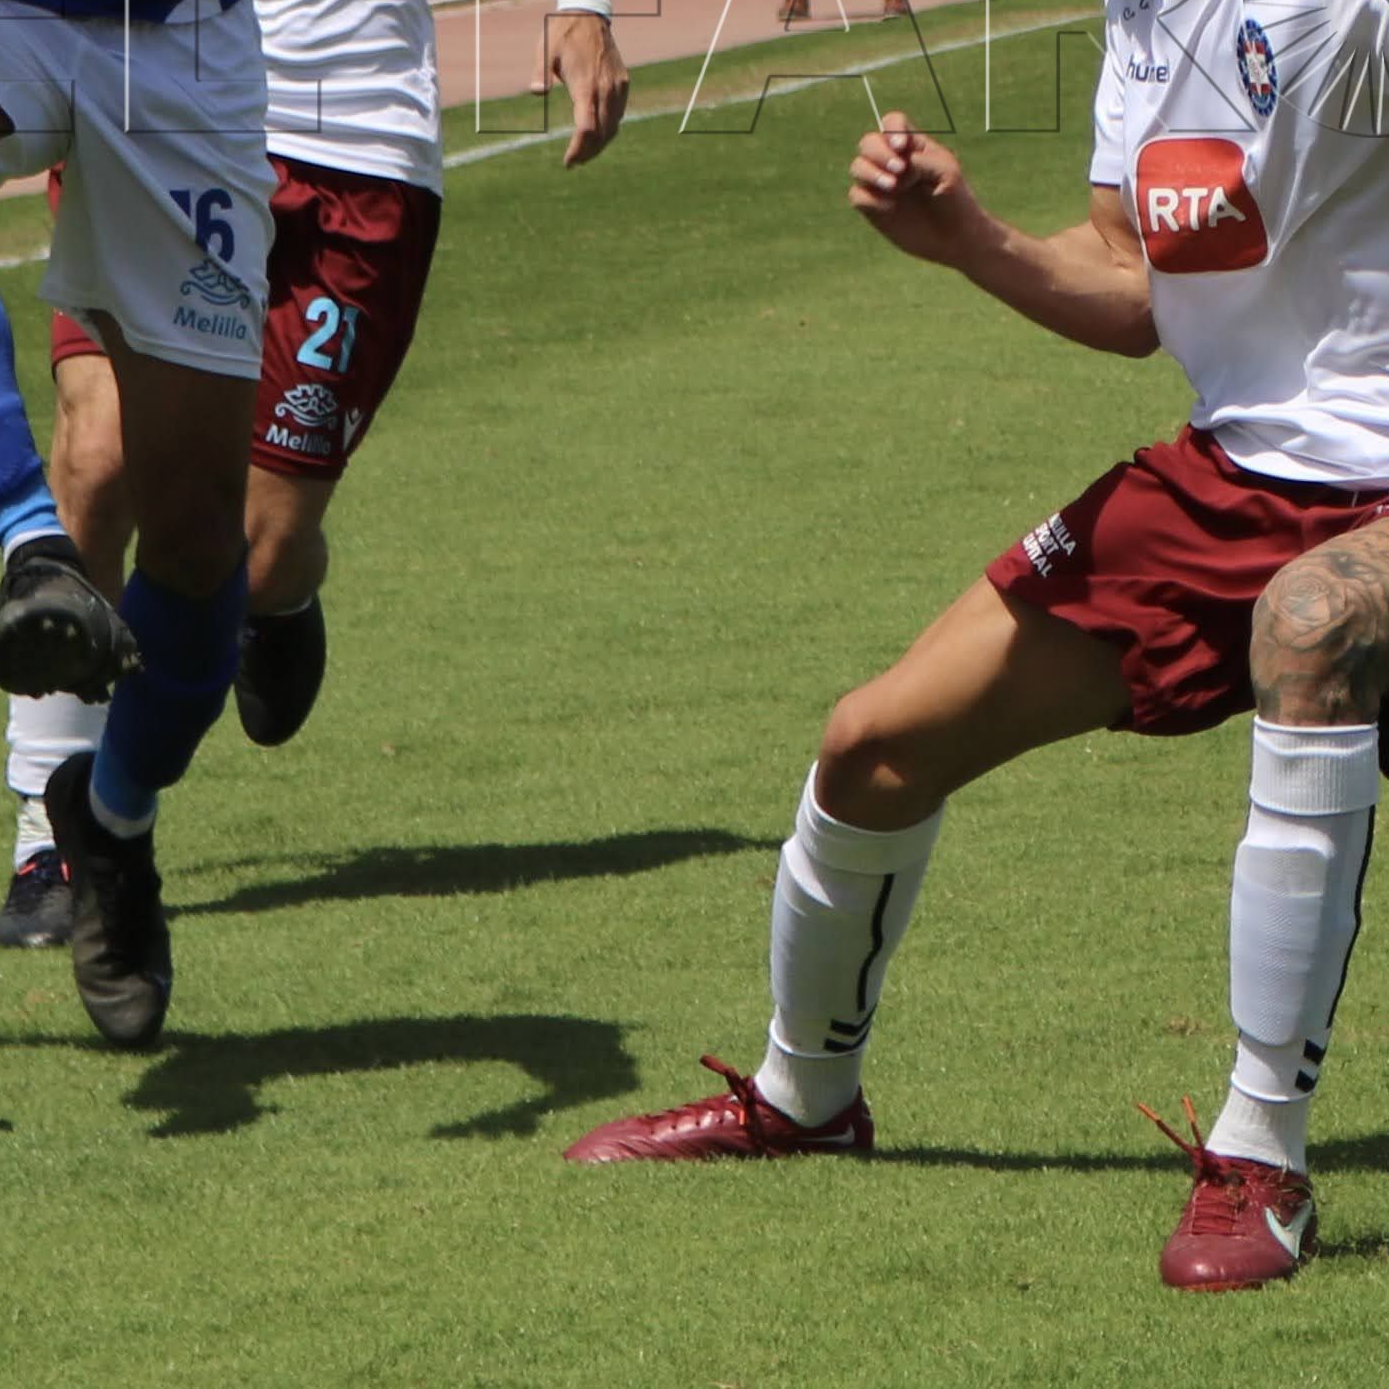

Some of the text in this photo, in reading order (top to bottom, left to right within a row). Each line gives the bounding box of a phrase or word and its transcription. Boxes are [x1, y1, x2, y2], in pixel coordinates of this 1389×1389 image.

[1148, 186, 1246, 233] RTA
[172, 306, 247, 341] Melilla
[296, 296, 361, 374] 21
[265, 423, 332, 456] Melilla
